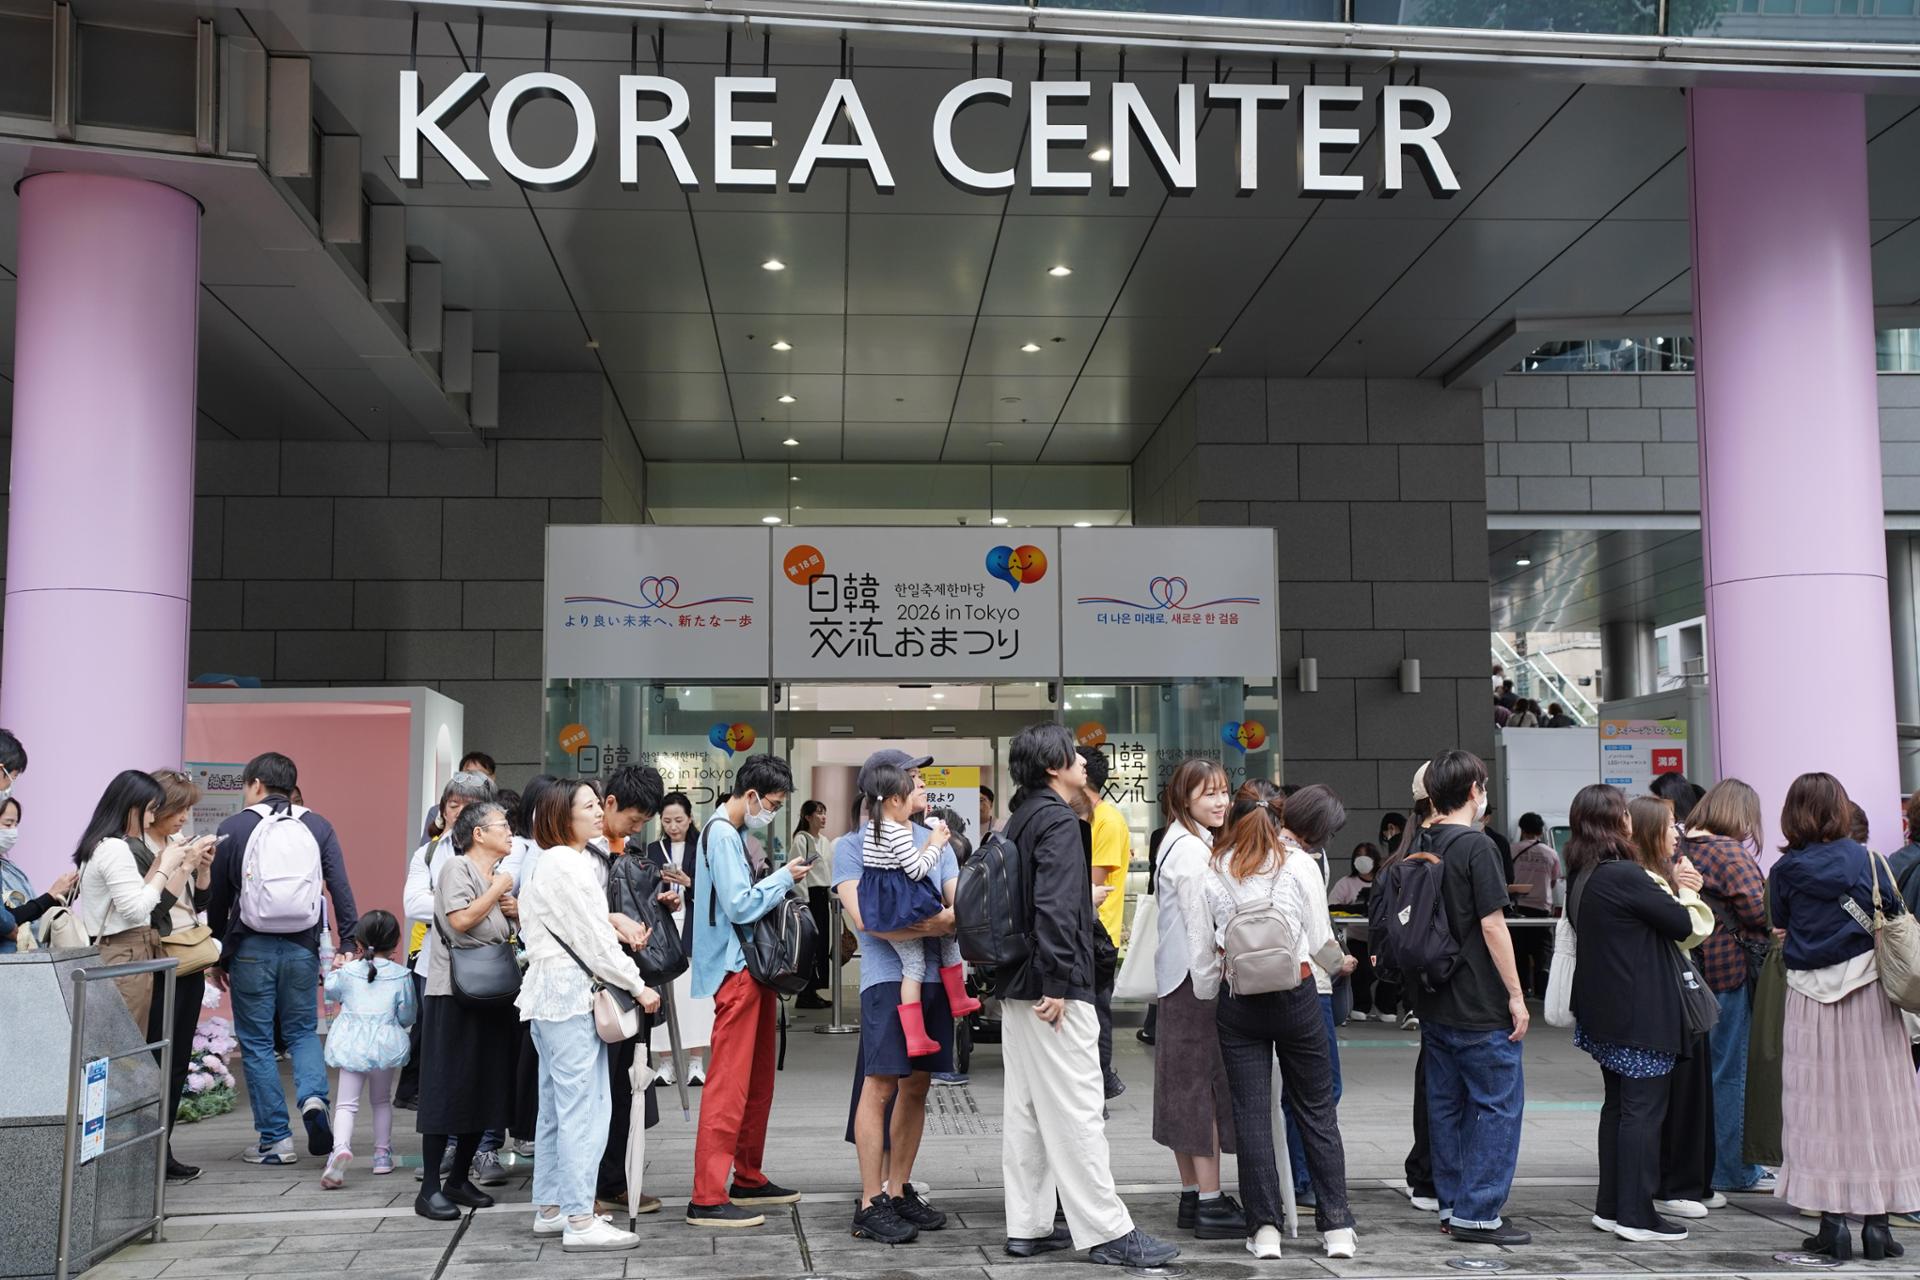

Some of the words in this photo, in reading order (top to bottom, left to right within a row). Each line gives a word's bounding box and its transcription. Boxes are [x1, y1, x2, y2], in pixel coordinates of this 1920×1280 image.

[400, 70, 895, 190] KOREA
[931, 77, 1461, 198] CENTER
[787, 554, 820, 577] 第18回
[809, 572, 880, 613] 日韓
[894, 583, 986, 598] 한일축제한마당
[564, 614, 752, 628] より良い未来へ、新たな一歩
[897, 604, 941, 620] 2026
[945, 604, 961, 620] in
[964, 604, 1020, 623] Tokyo
[1097, 613, 1108, 625] 더
[1111, 613, 1131, 625] 나은
[1134, 613, 1168, 625] 미래로,
[1171, 613, 1201, 625] 새로운
[1205, 613, 1216, 625] 한
[1218, 613, 1240, 625] 걸음
[809, 616, 1020, 660] 交流おまつり
[679, 767, 690, 779] in
[693, 767, 734, 781] Tokyo
